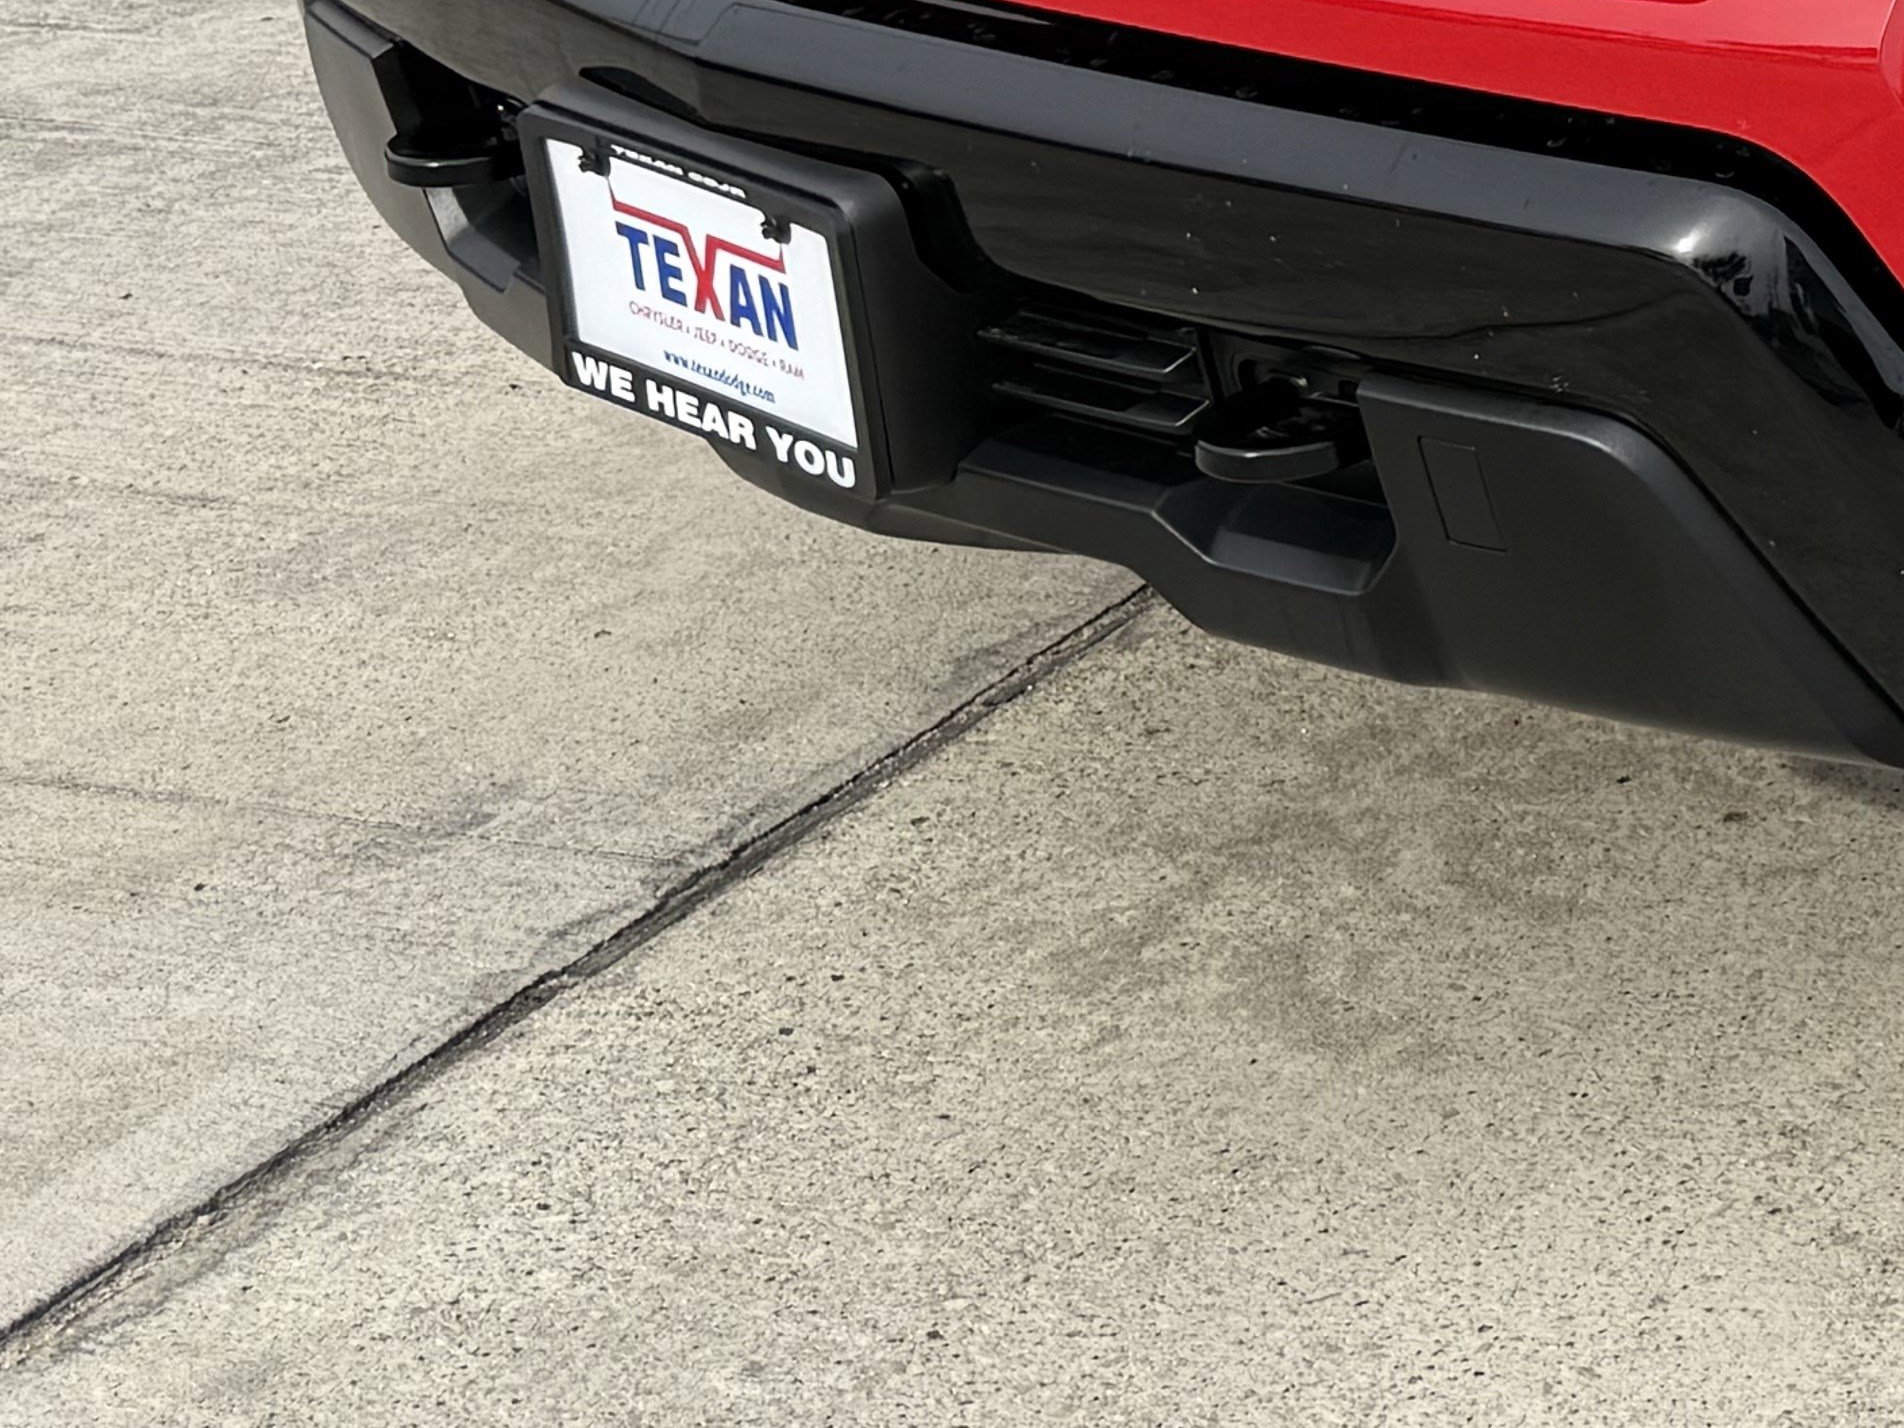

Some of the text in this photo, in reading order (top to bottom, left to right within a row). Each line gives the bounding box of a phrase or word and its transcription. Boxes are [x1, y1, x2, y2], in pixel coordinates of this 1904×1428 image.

[611, 200, 800, 352] TEXAN
[571, 350, 857, 489] WE HEAR YOU
